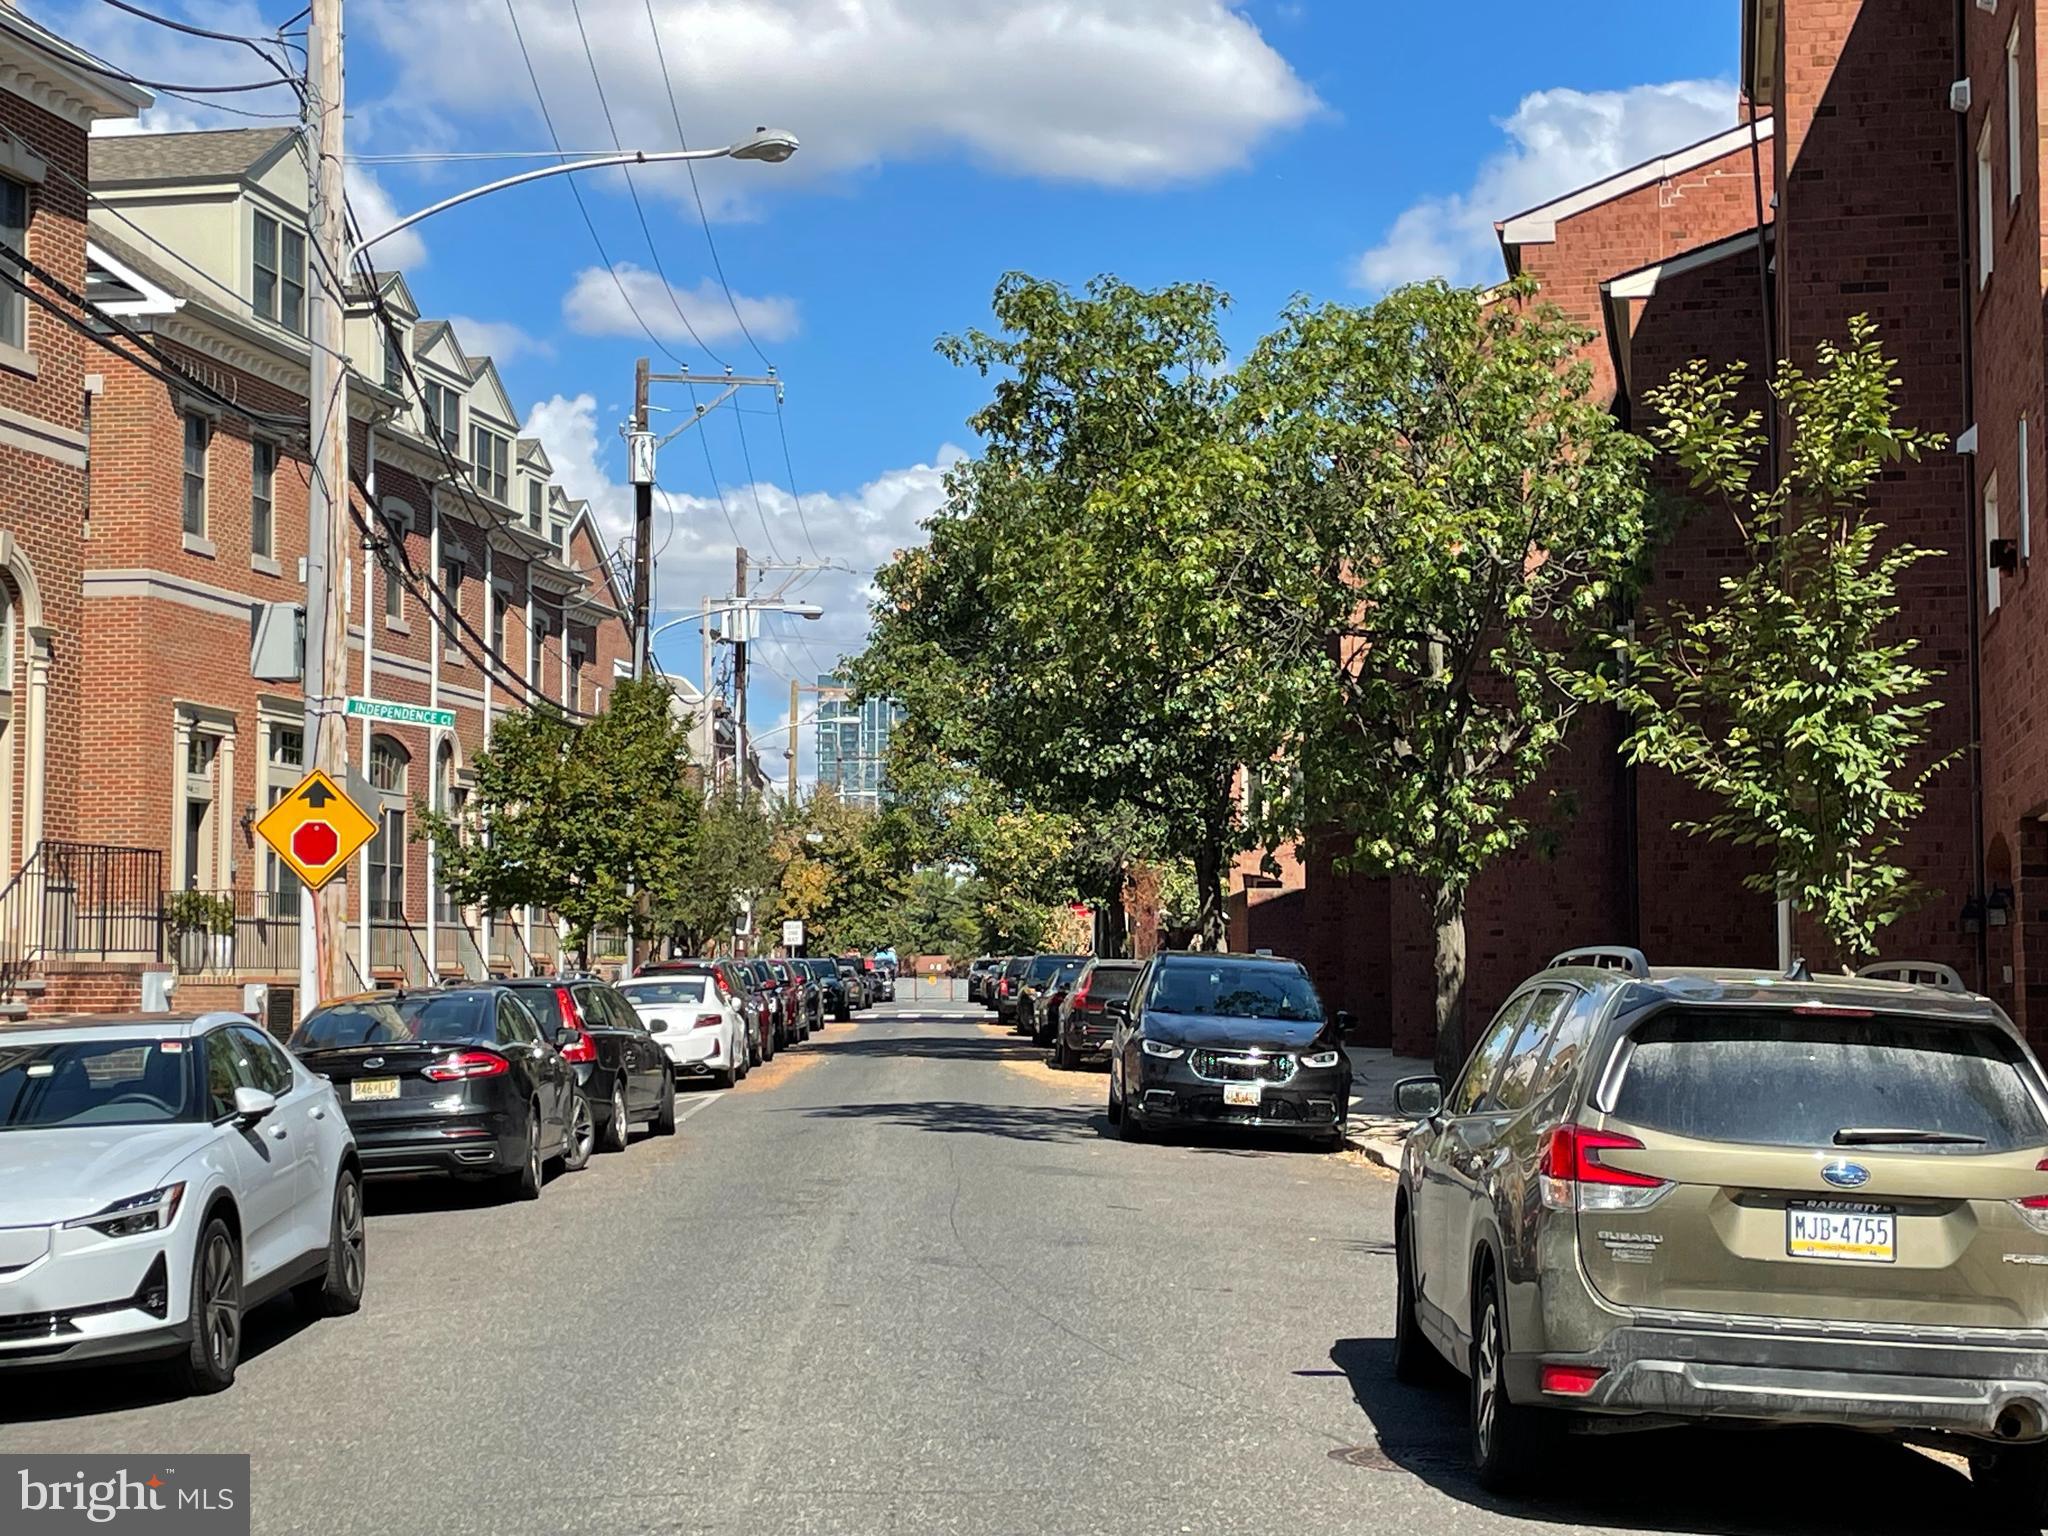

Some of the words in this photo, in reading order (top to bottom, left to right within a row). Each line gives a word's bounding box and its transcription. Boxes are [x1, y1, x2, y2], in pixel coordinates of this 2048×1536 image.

[354, 702, 437, 723] INDEPENDENCE
[1806, 1200, 1881, 1213] RAFFERTY
[1597, 1231, 1664, 1243] SUBARU
